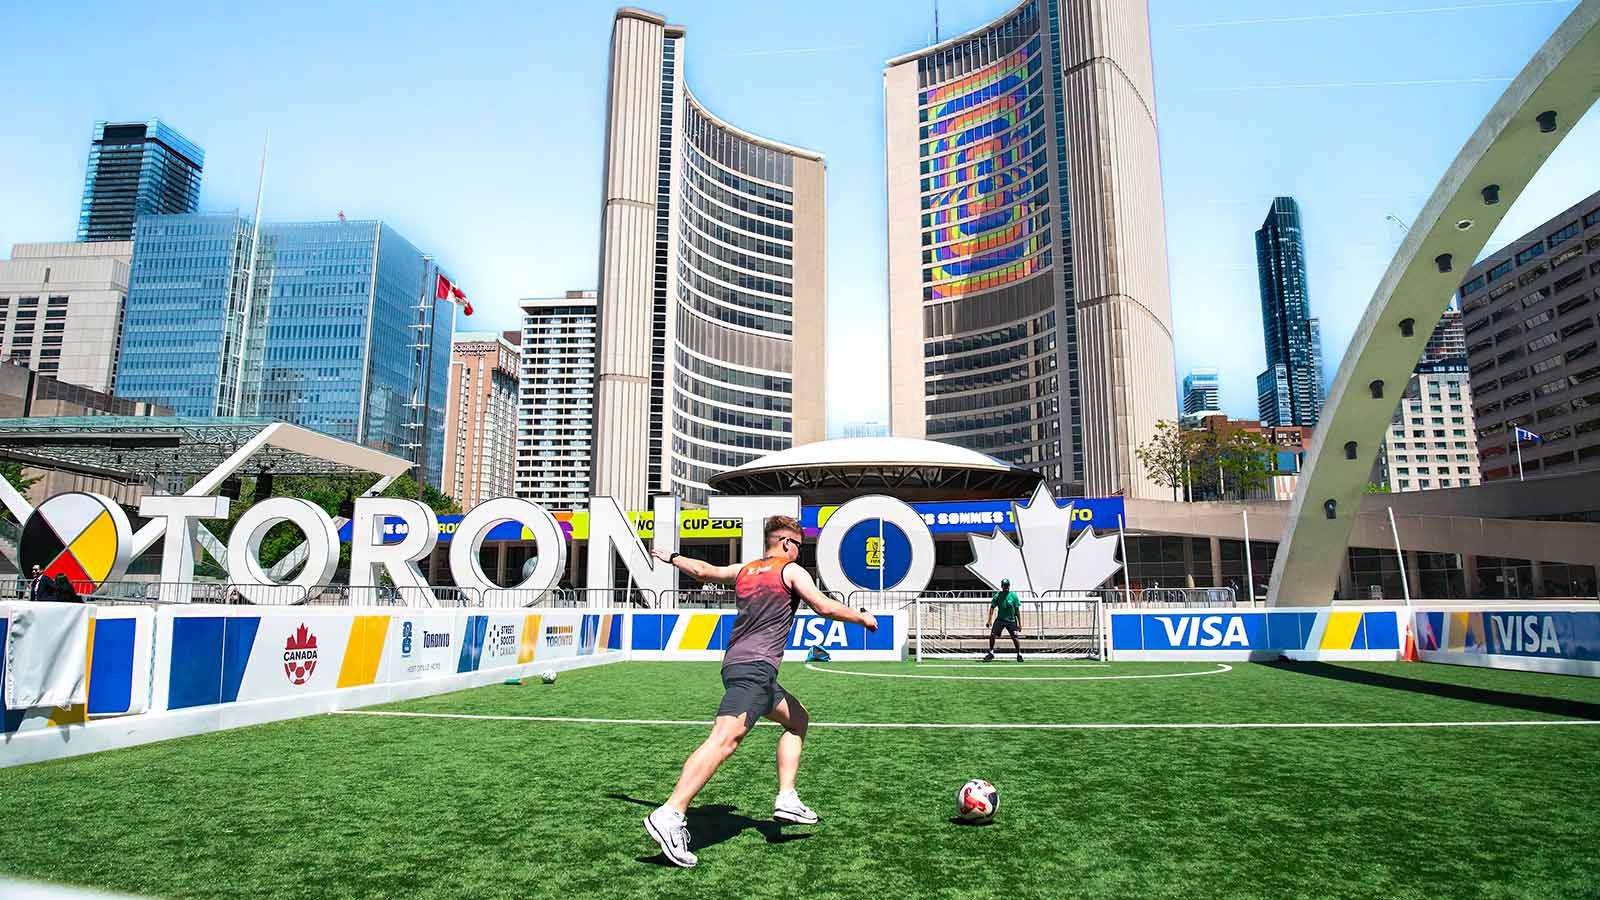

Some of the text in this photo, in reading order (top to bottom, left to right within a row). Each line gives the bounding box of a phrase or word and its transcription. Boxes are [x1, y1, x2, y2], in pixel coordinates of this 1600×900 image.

[683, 518, 709, 530] CUP
[139, 494, 935, 607] TORONTO
[790, 618, 848, 647] ISA
[1154, 616, 1249, 647] VISA
[1490, 615, 1561, 654] VISA
[283, 650, 318, 661] CANADA
